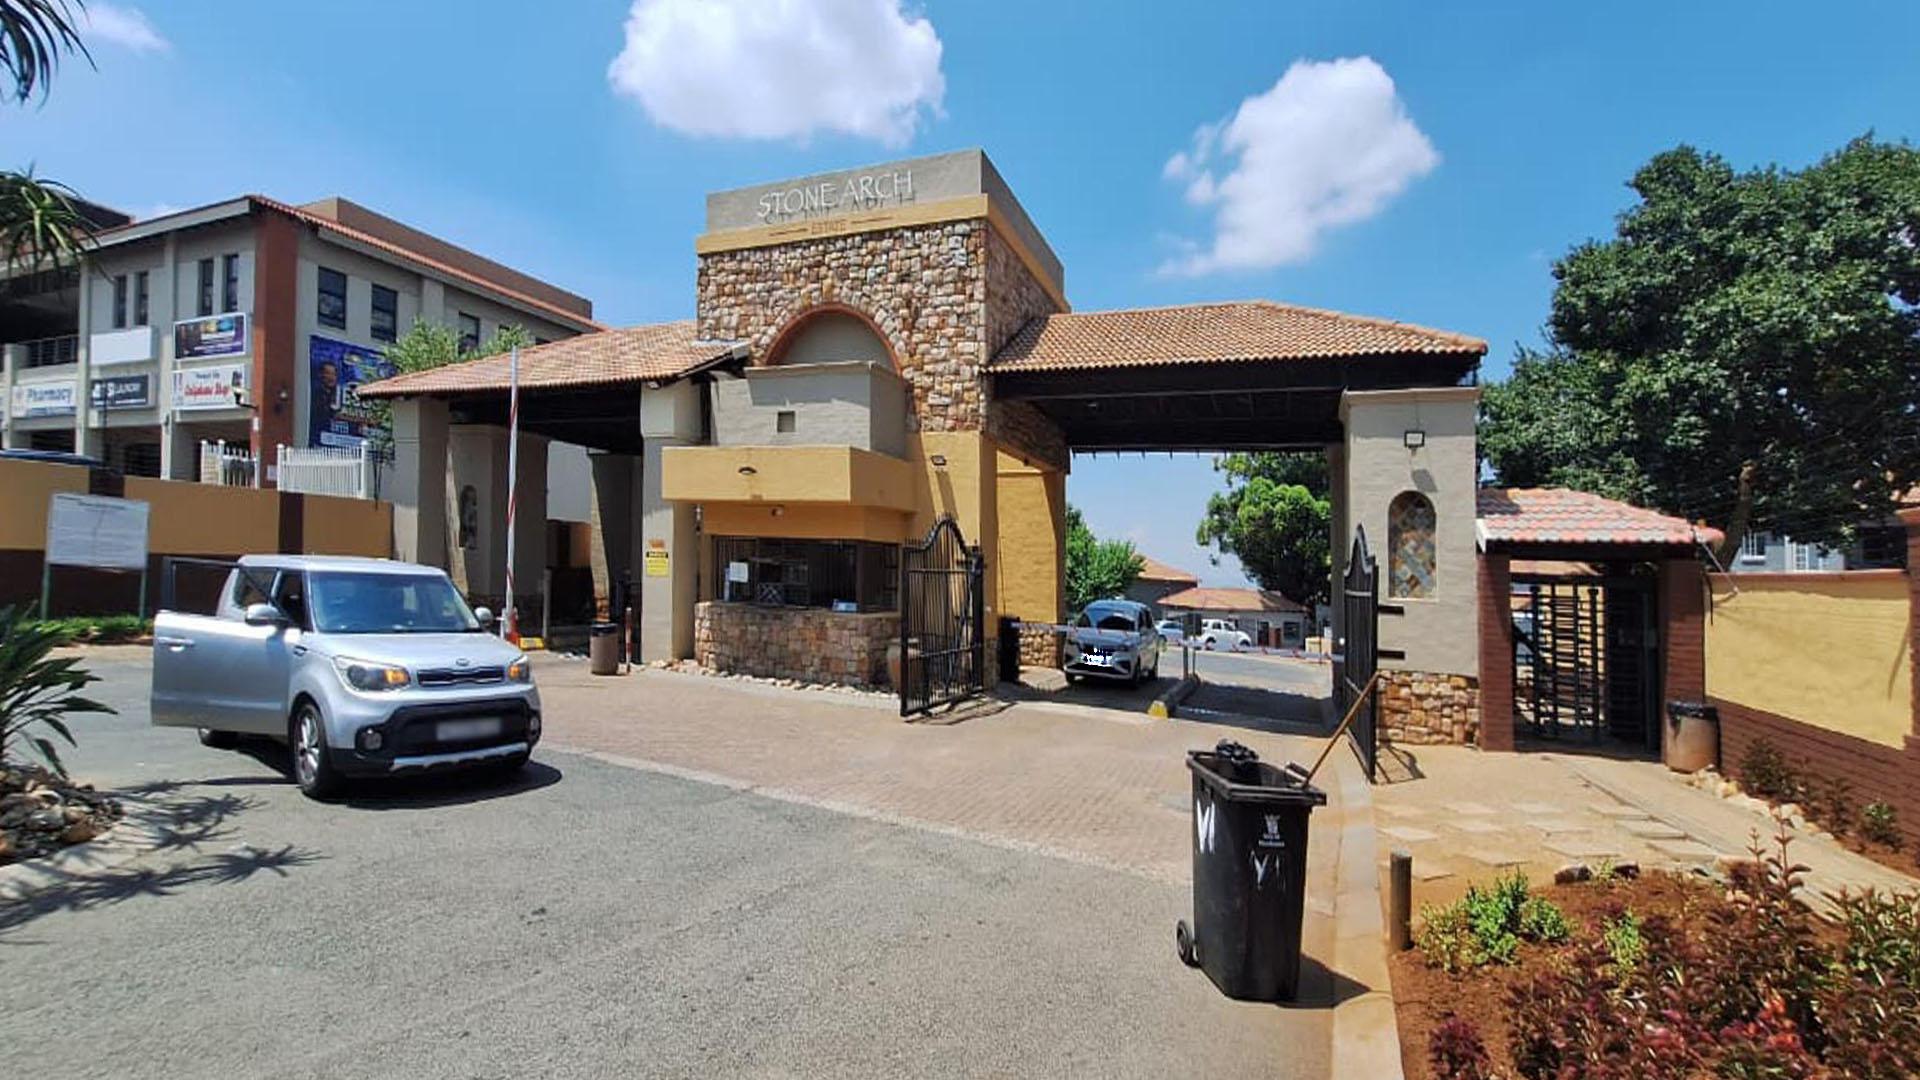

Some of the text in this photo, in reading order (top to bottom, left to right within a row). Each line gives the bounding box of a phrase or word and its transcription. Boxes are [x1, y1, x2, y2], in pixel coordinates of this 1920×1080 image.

[758, 169, 912, 217] STONE ARCH
[811, 219, 847, 235] ESTATE
[27, 387, 73, 404] Pharmacy
